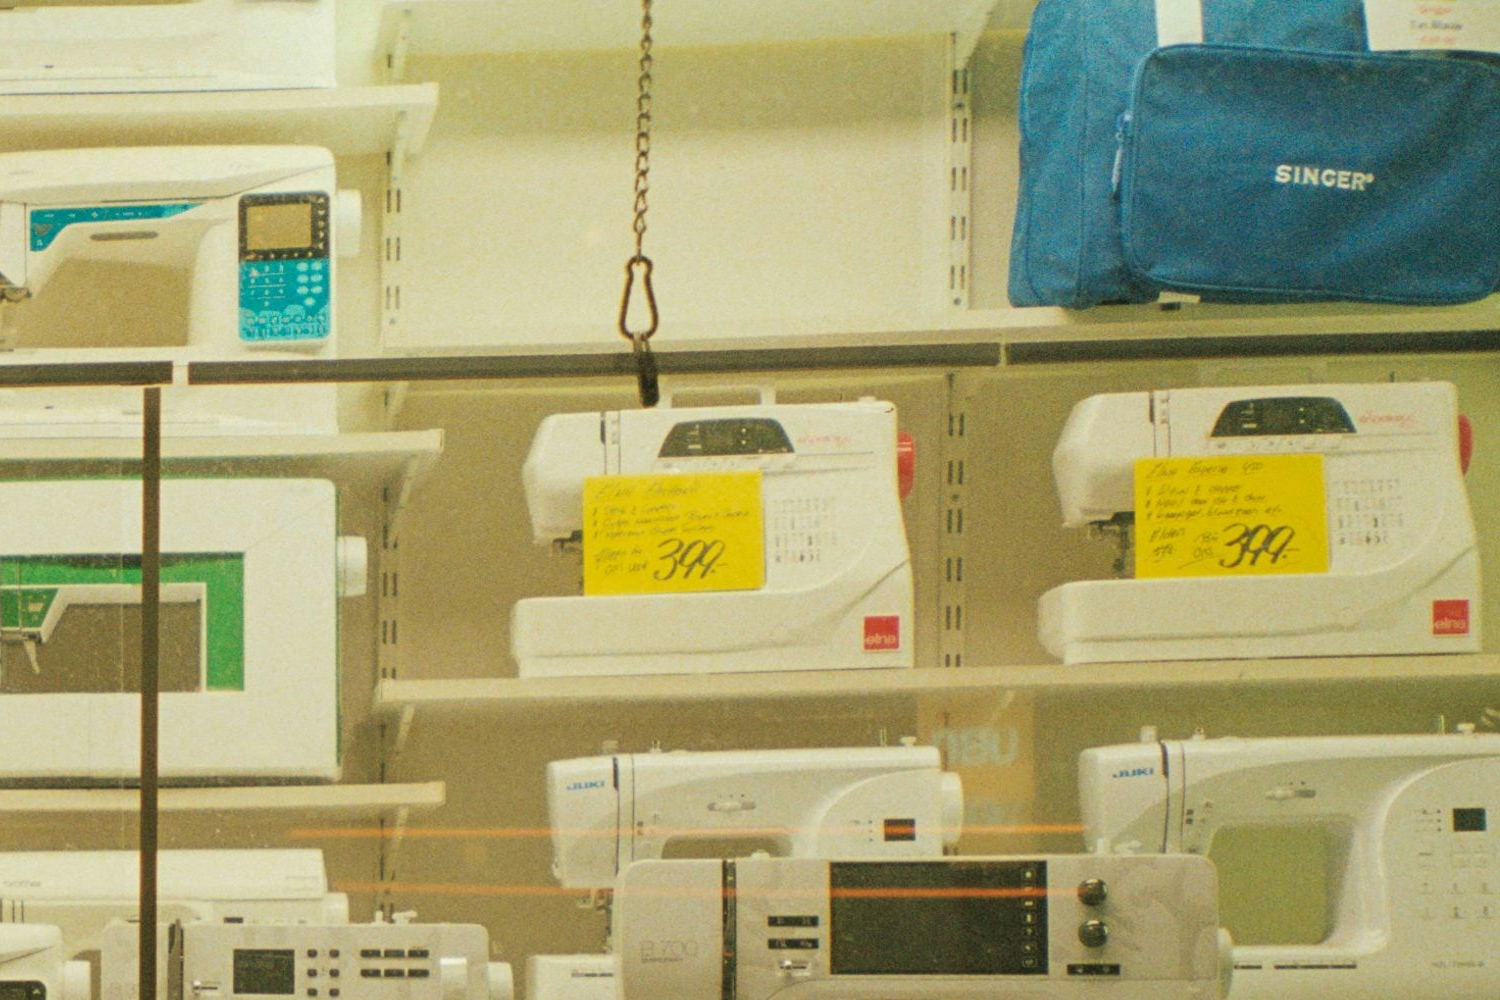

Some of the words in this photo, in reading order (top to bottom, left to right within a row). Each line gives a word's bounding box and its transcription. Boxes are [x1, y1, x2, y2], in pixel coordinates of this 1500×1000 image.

[1274, 164, 1366, 191] SINGER
[1113, 768, 1155, 779] JUKI
[566, 780, 605, 791] JUKI
